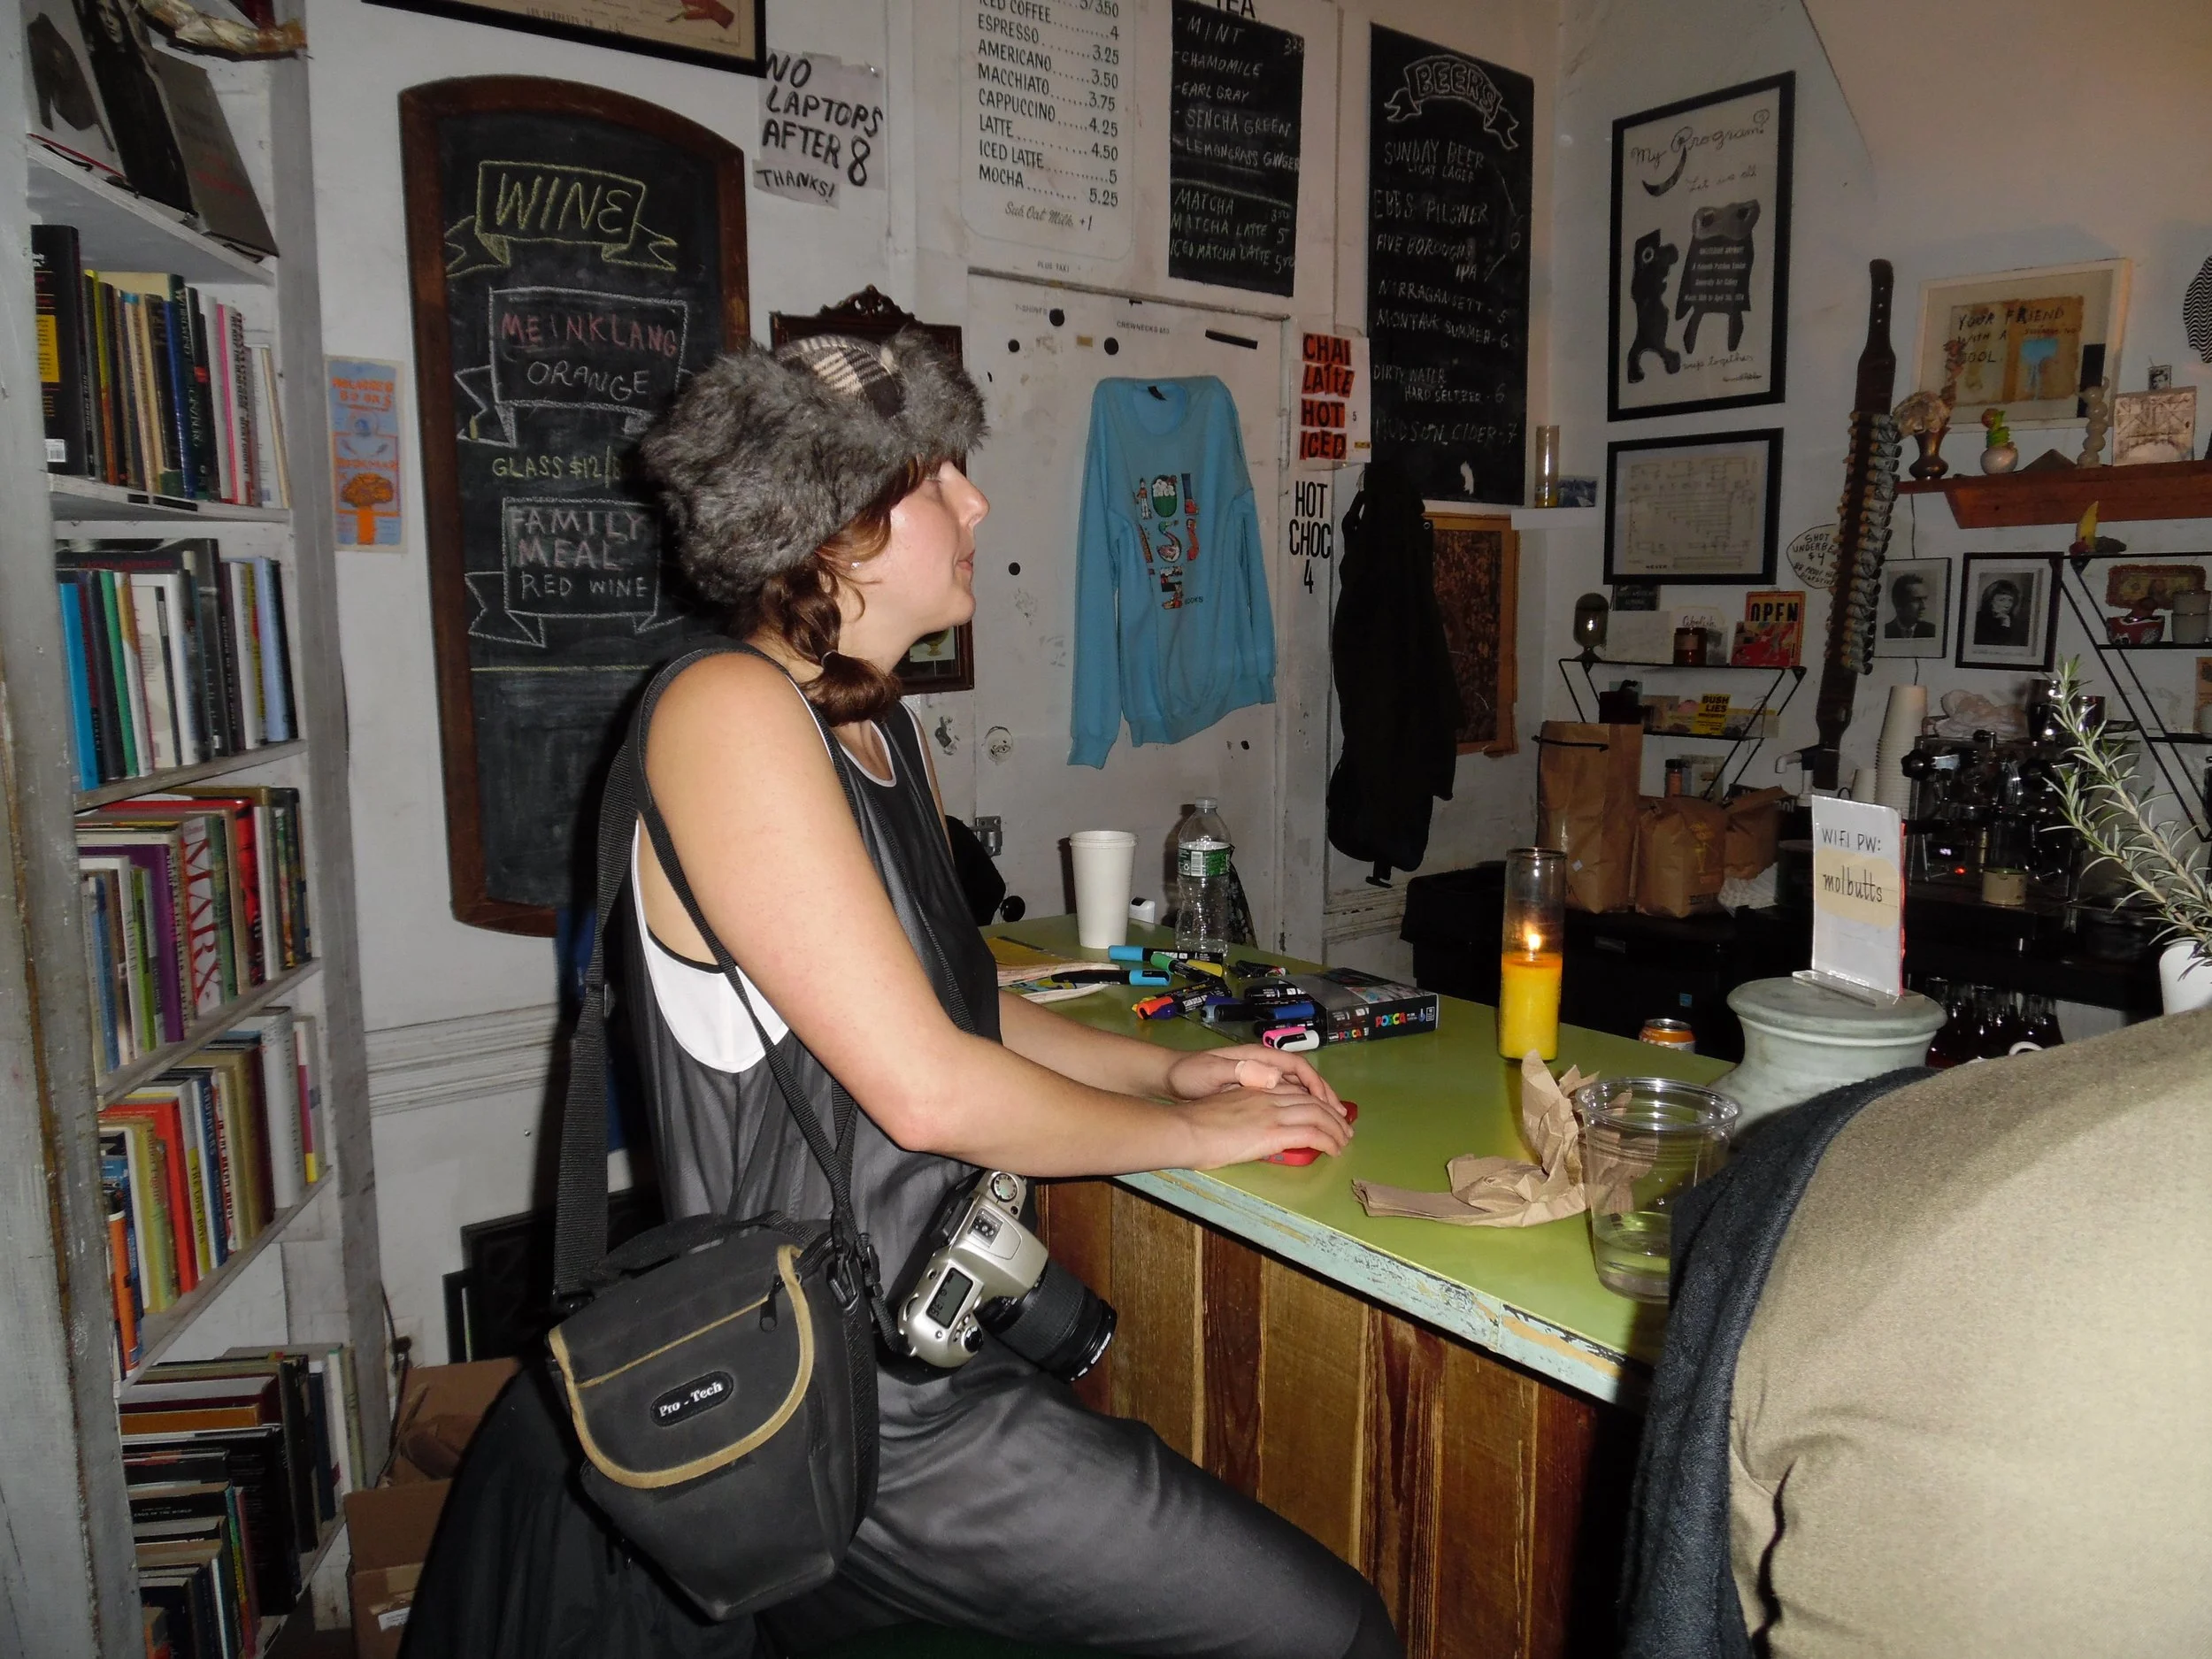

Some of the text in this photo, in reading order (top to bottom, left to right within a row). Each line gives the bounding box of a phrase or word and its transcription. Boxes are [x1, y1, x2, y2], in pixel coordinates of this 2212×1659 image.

[1010, 0, 1119, 41] COFFEE 4
[1187, 15, 1245, 43] MINT
[978, 13, 1119, 65] ESPRESSO 3.25
[766, 51, 812, 88] NO
[978, 39, 1118, 89] AMERICANO 3.50
[1181, 50, 1263, 76] CHAMOMILE
[978, 63, 1116, 112] MACCHIATO 3.75
[1181, 81, 1249, 103] EARL GRAY
[1416, 61, 1496, 113] BEERS
[765, 84, 884, 138] LAPTOPS
[979, 88, 1118, 138] CAPPUCCINO 4.25
[1185, 108, 1292, 137] SENCHA GREEN
[762, 118, 872, 188] AFTER 8
[979, 114, 1118, 162] LATTE 4.50
[1186, 136, 1259, 166] LEMONGRASS
[1385, 138, 1485, 169] SUNDAY BEER
[979, 139, 1118, 184] ICED LATTE 5
[1408, 163, 1474, 183] LIGHT LAGER
[1631, 146, 1668, 173] My
[756, 169, 836, 204] THANKS!
[979, 164, 1118, 208] MOCHA 5.25
[495, 172, 633, 234] WINE
[1174, 188, 1234, 216] MATCHA
[1426, 200, 1488, 225] PILSNER
[1170, 212, 1290, 244] MATCHA LATTE 5
[1170, 239, 1271, 266] ICED MATCHA LATTE
[1376, 234, 1404, 254] FIVE
[1455, 264, 1478, 282] IPA
[1377, 309, 1509, 349] MONTAUK SUMMER 6
[2005, 304, 2065, 326] FRIEND
[500, 311, 678, 357] MEINKLANG
[1303, 333, 1350, 365] CHAI
[1999, 330, 2008, 341] A
[527, 360, 650, 401] ORANGE
[1373, 364, 1405, 384] DIRTY
[1404, 385, 1432, 402] HARD
[1434, 389, 1482, 403] SELTZER
[1302, 400, 1344, 427] HOT
[1301, 431, 1347, 459] ICED
[1451, 422, 1496, 444] CIDER
[492, 456, 564, 479] GLASS
[1295, 480, 1328, 518] HOT
[509, 510, 648, 541] FAMILY
[1289, 519, 1332, 559] CHOC
[1804, 533, 1831, 543] SHOT
[517, 538, 625, 571] MEAL
[521, 571, 649, 600] RED WINE
[1303, 559, 1314, 594] 4
[1701, 695, 1730, 703] BUSH
[1822, 827, 1882, 853] WIFI PW:
[1823, 864, 1883, 902] molbutts
[181, 837, 221, 1005] MARX
[1375, 1012, 1407, 1027] POSCA
[658, 1401, 681, 1417] Pro
[690, 1380, 724, 1402] Tech
